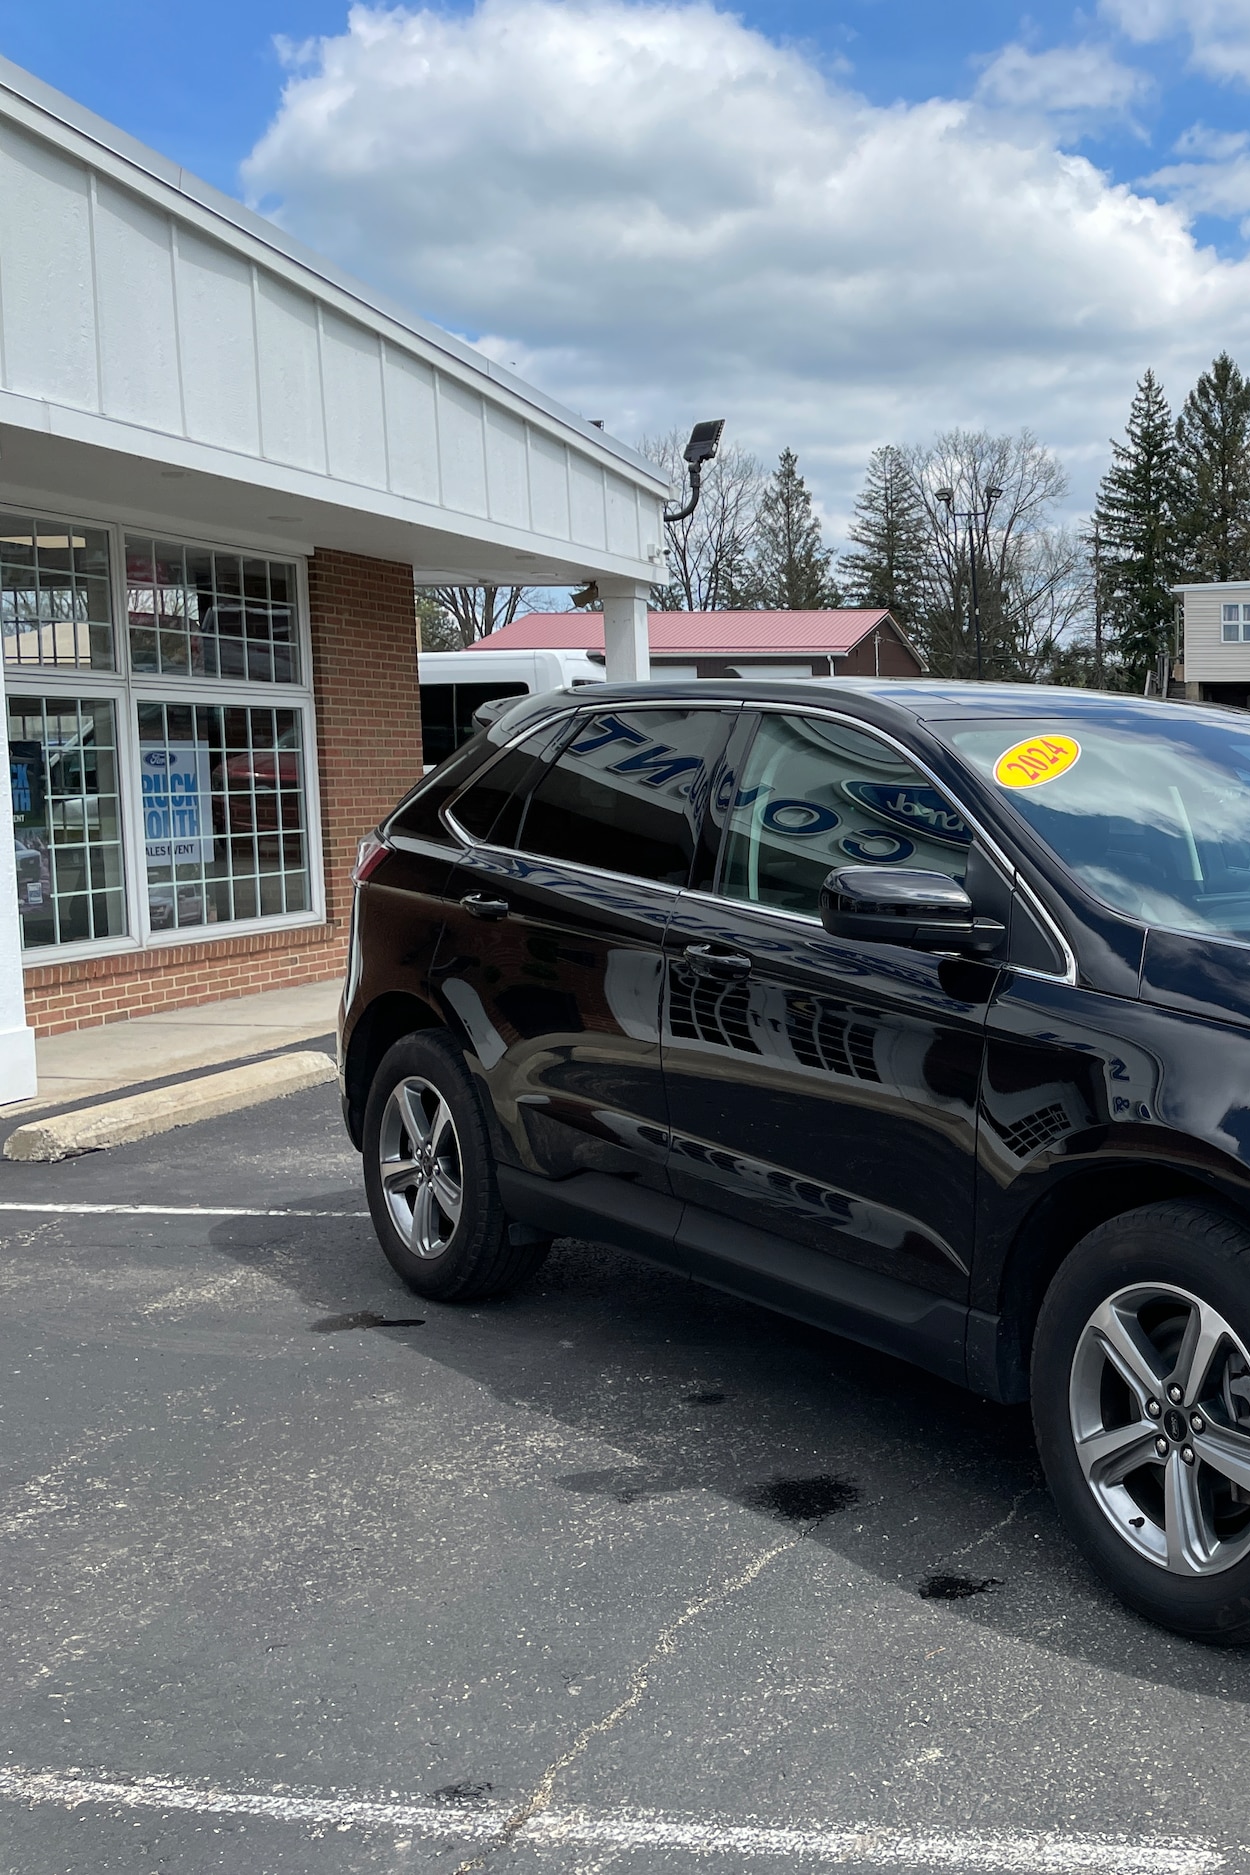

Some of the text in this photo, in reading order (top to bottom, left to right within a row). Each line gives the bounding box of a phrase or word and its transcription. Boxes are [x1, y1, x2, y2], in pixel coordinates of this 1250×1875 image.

[150, 752, 168, 765] For
[1006, 739, 1069, 780] 2024
[141, 773, 198, 808] RUCK
[144, 809, 198, 839] ONTH
[146, 846, 166, 856] ALES
